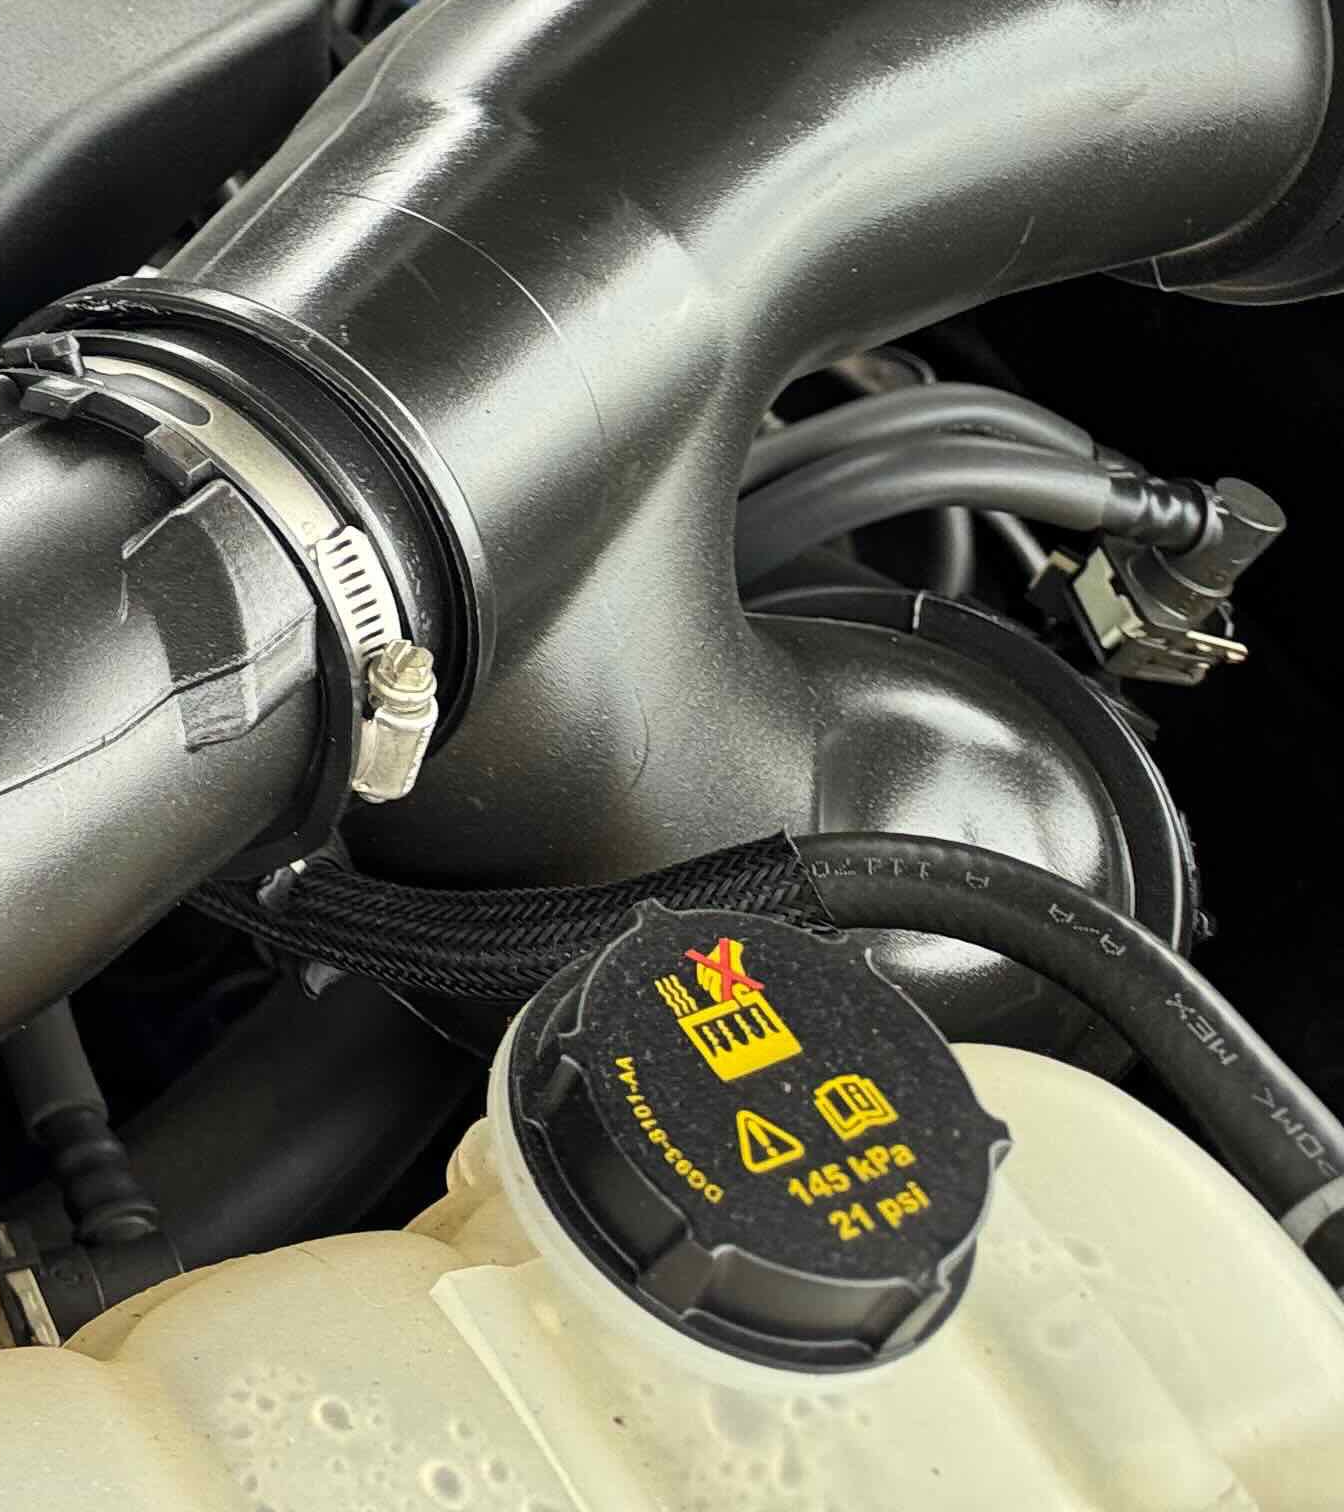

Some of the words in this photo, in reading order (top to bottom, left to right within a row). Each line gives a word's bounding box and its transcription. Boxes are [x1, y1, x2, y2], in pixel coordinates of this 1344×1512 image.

[1165, 992, 1239, 1066] MEX
[787, 1162, 852, 1206] 145
[855, 1142, 917, 1183] kPa
[828, 1202, 876, 1241] 21
[877, 1180, 929, 1228] psi
